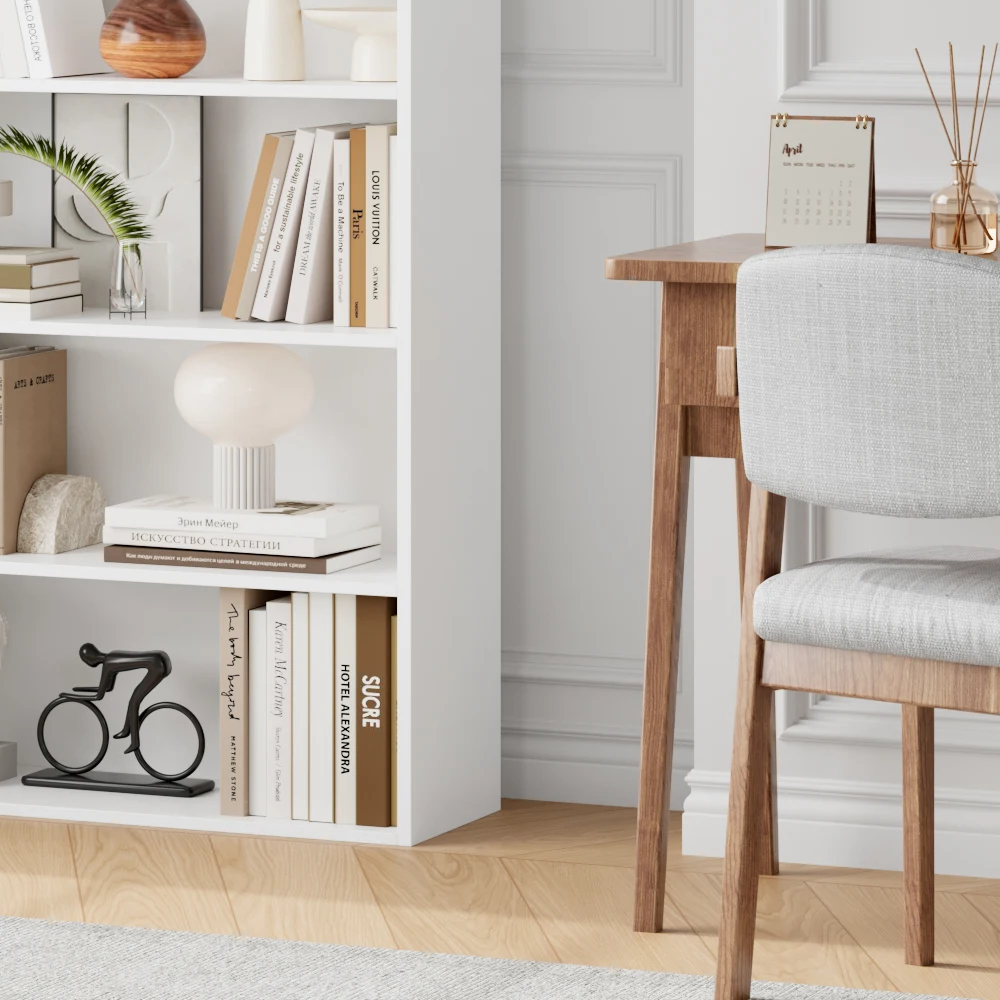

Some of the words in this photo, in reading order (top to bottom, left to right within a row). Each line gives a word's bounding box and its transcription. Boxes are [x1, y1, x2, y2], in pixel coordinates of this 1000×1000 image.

[782, 143, 803, 157] April
[266, 177, 280, 205] GUIDE
[337, 181, 345, 192] To
[371, 170, 380, 200] LOUIS
[273, 239, 282, 253] for
[279, 185, 296, 233] sustainable
[290, 152, 304, 185] lifestyle
[337, 194, 345, 208] Be
[260, 206, 273, 235] GOOD
[299, 240, 312, 276] DREAM
[311, 178, 321, 211] AWAKE
[337, 216, 345, 253] Machine
[352, 208, 364, 240] Paris
[371, 203, 380, 245] VUITTON
[256, 242, 264, 252] IS
[258, 234, 266, 243] A
[250, 251, 261, 273] THIS
[13, 378, 27, 389] ARTS
[29, 376, 34, 386] &
[35, 373, 55, 385] CRAFTS
[177, 516, 203, 527] Эрин
[205, 517, 239, 530] Мейер
[131, 532, 206, 546] ИСКУССТВО
[209, 537, 281, 550] СТРАТЕГИИ
[181, 555, 216, 563] добиваются
[240, 559, 288, 567] международной
[227, 603, 240, 632] The
[274, 620, 287, 654] Karen
[271, 657, 287, 718] McCartney
[340, 664, 350, 702] HOTEL
[361, 674, 381, 728] SUCRE
[340, 703, 350, 775] ALEXANDRA
